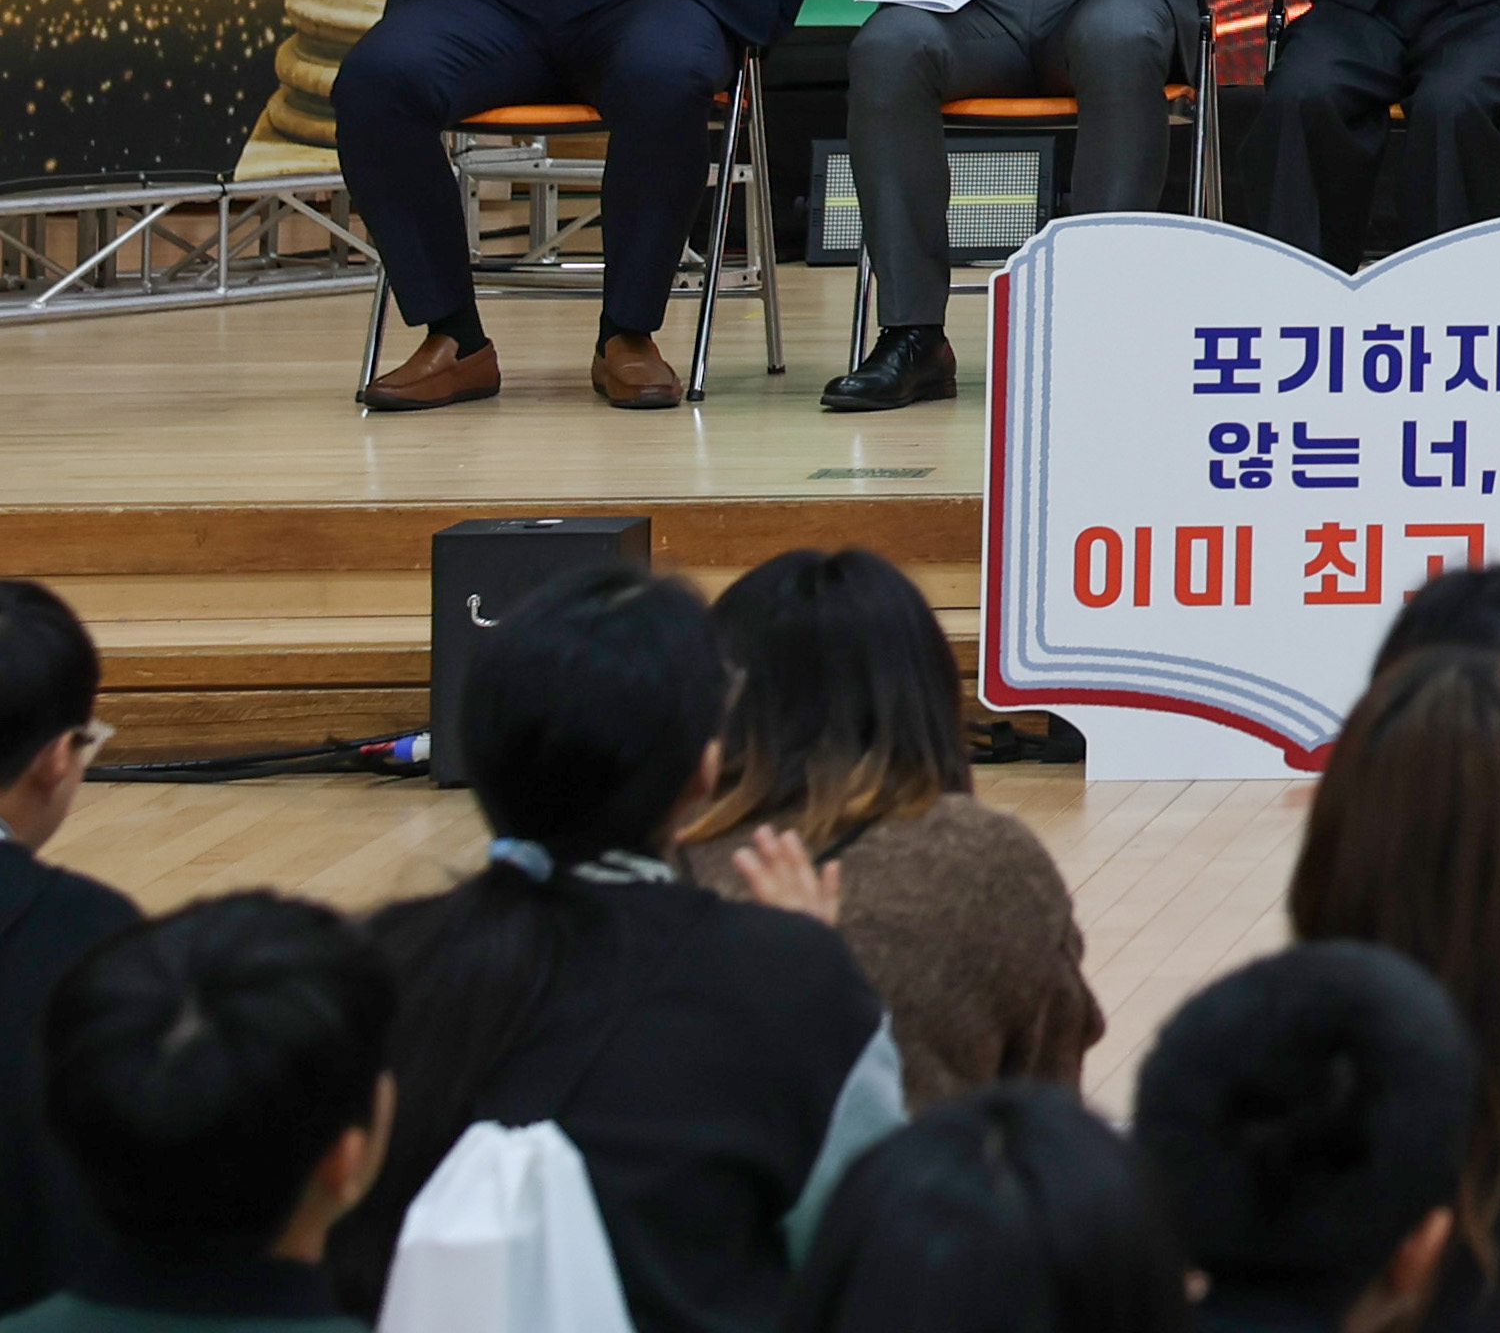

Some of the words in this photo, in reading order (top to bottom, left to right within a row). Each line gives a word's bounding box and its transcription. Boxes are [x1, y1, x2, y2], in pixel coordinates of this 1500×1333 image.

[1208, 420, 1362, 491] 않는
[1400, 419, 1499, 495] 너,
[1072, 525, 1254, 609] 이미
